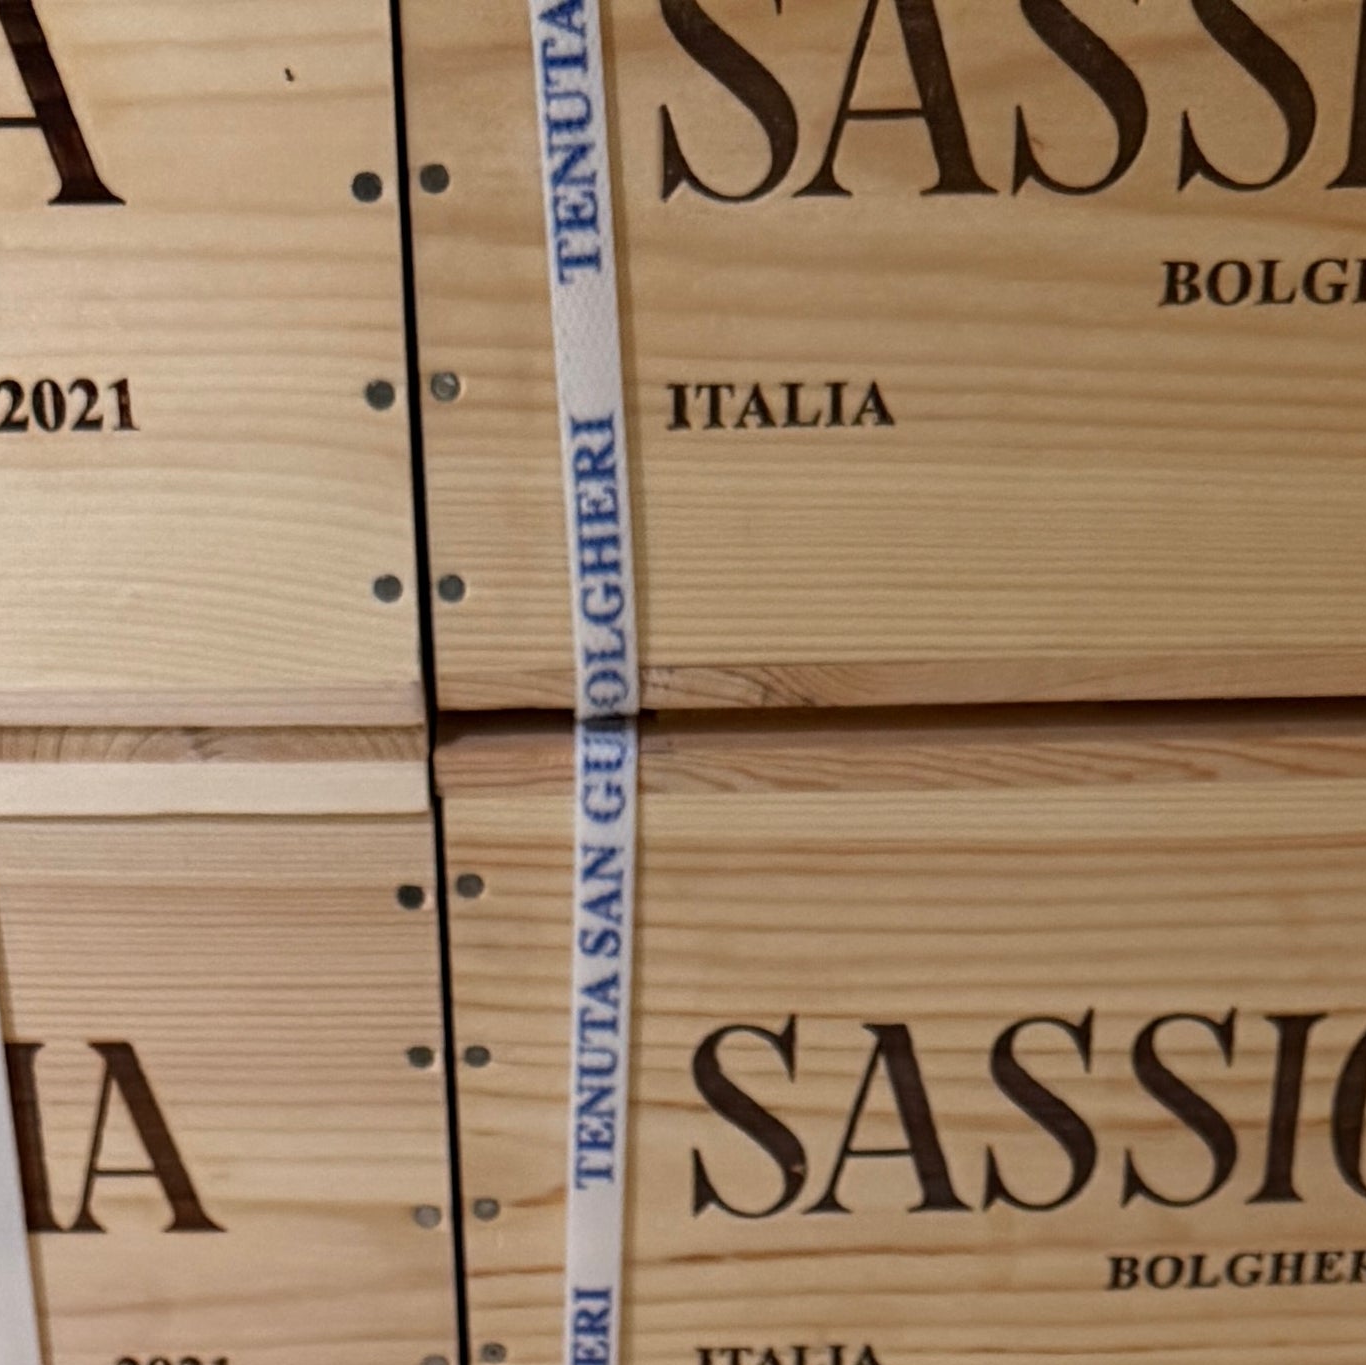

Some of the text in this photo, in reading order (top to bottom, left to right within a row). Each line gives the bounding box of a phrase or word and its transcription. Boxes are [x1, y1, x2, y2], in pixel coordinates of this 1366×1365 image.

[539, 0, 602, 284] TENUTA
[665, 380, 896, 430] ITALIA
[580, 845, 623, 956] SAN
[575, 974, 620, 1189] TENUTA
